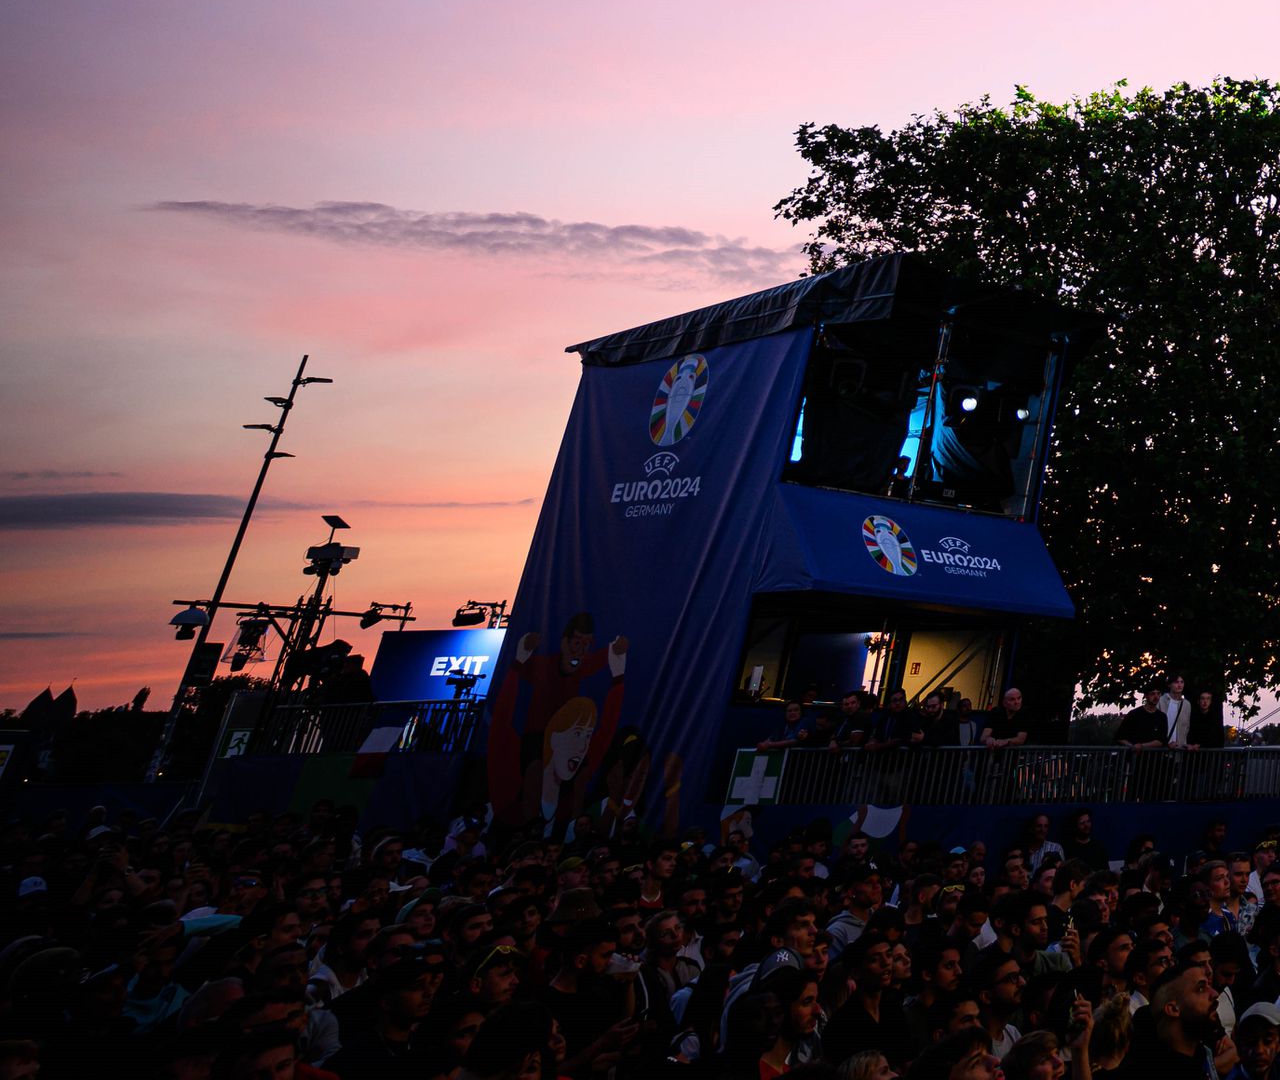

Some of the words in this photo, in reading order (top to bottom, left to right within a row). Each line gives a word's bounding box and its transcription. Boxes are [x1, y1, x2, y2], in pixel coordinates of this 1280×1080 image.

[644, 455, 676, 473] UEFA
[610, 476, 702, 503] EURO2024
[624, 503, 675, 518] GERMANY
[940, 539, 969, 552] UEFA
[920, 549, 1001, 571] EURO2024
[944, 566, 988, 578] GERMANY
[429, 655, 490, 677] EXIT
